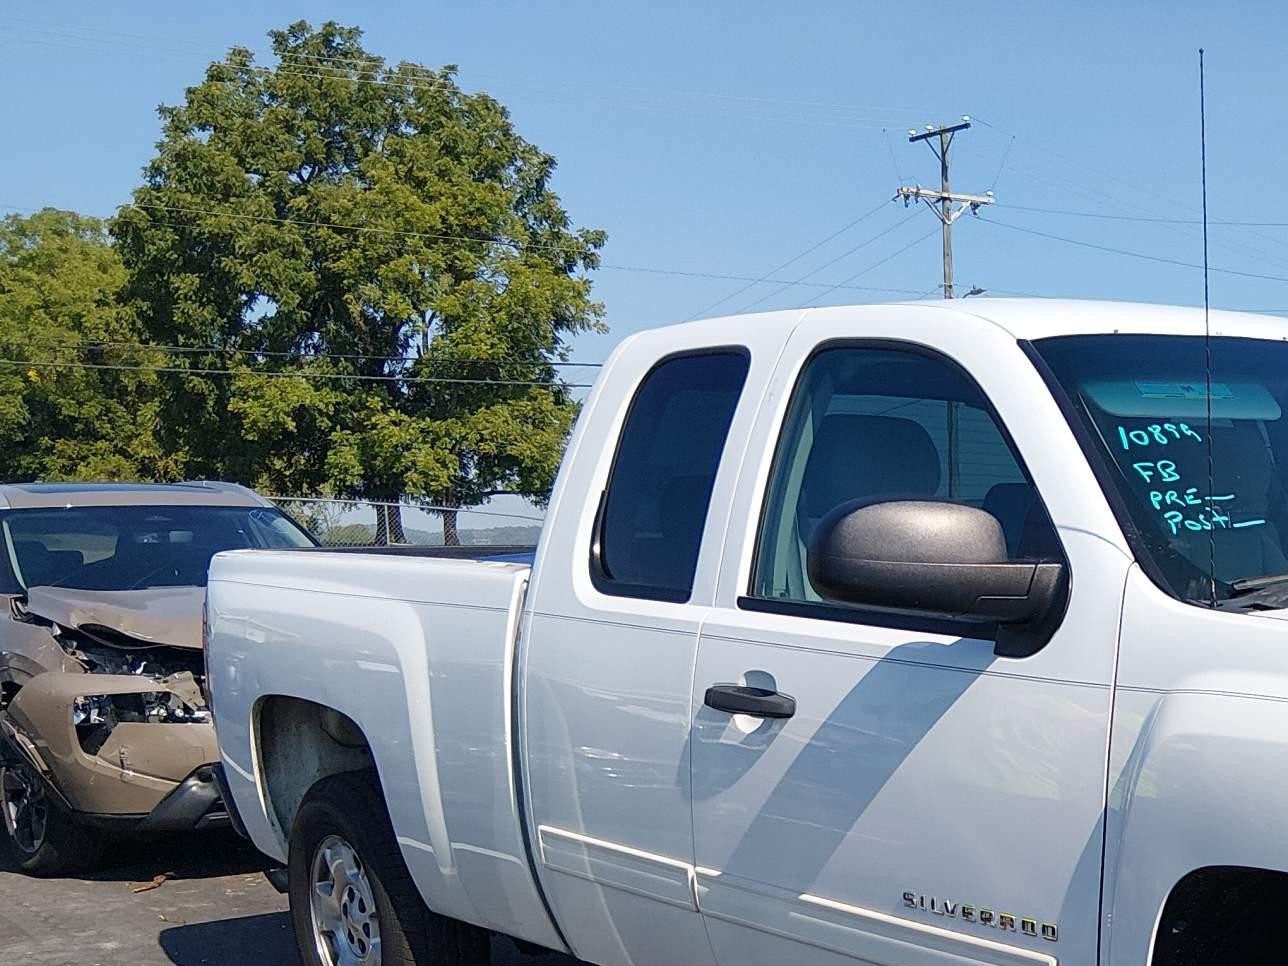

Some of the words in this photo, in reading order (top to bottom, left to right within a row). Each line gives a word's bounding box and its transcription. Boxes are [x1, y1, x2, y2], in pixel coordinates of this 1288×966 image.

[1132, 460, 1181, 484] FB
[1149, 488, 1202, 510] PRE
[902, 891, 1059, 942] SILVERADO
